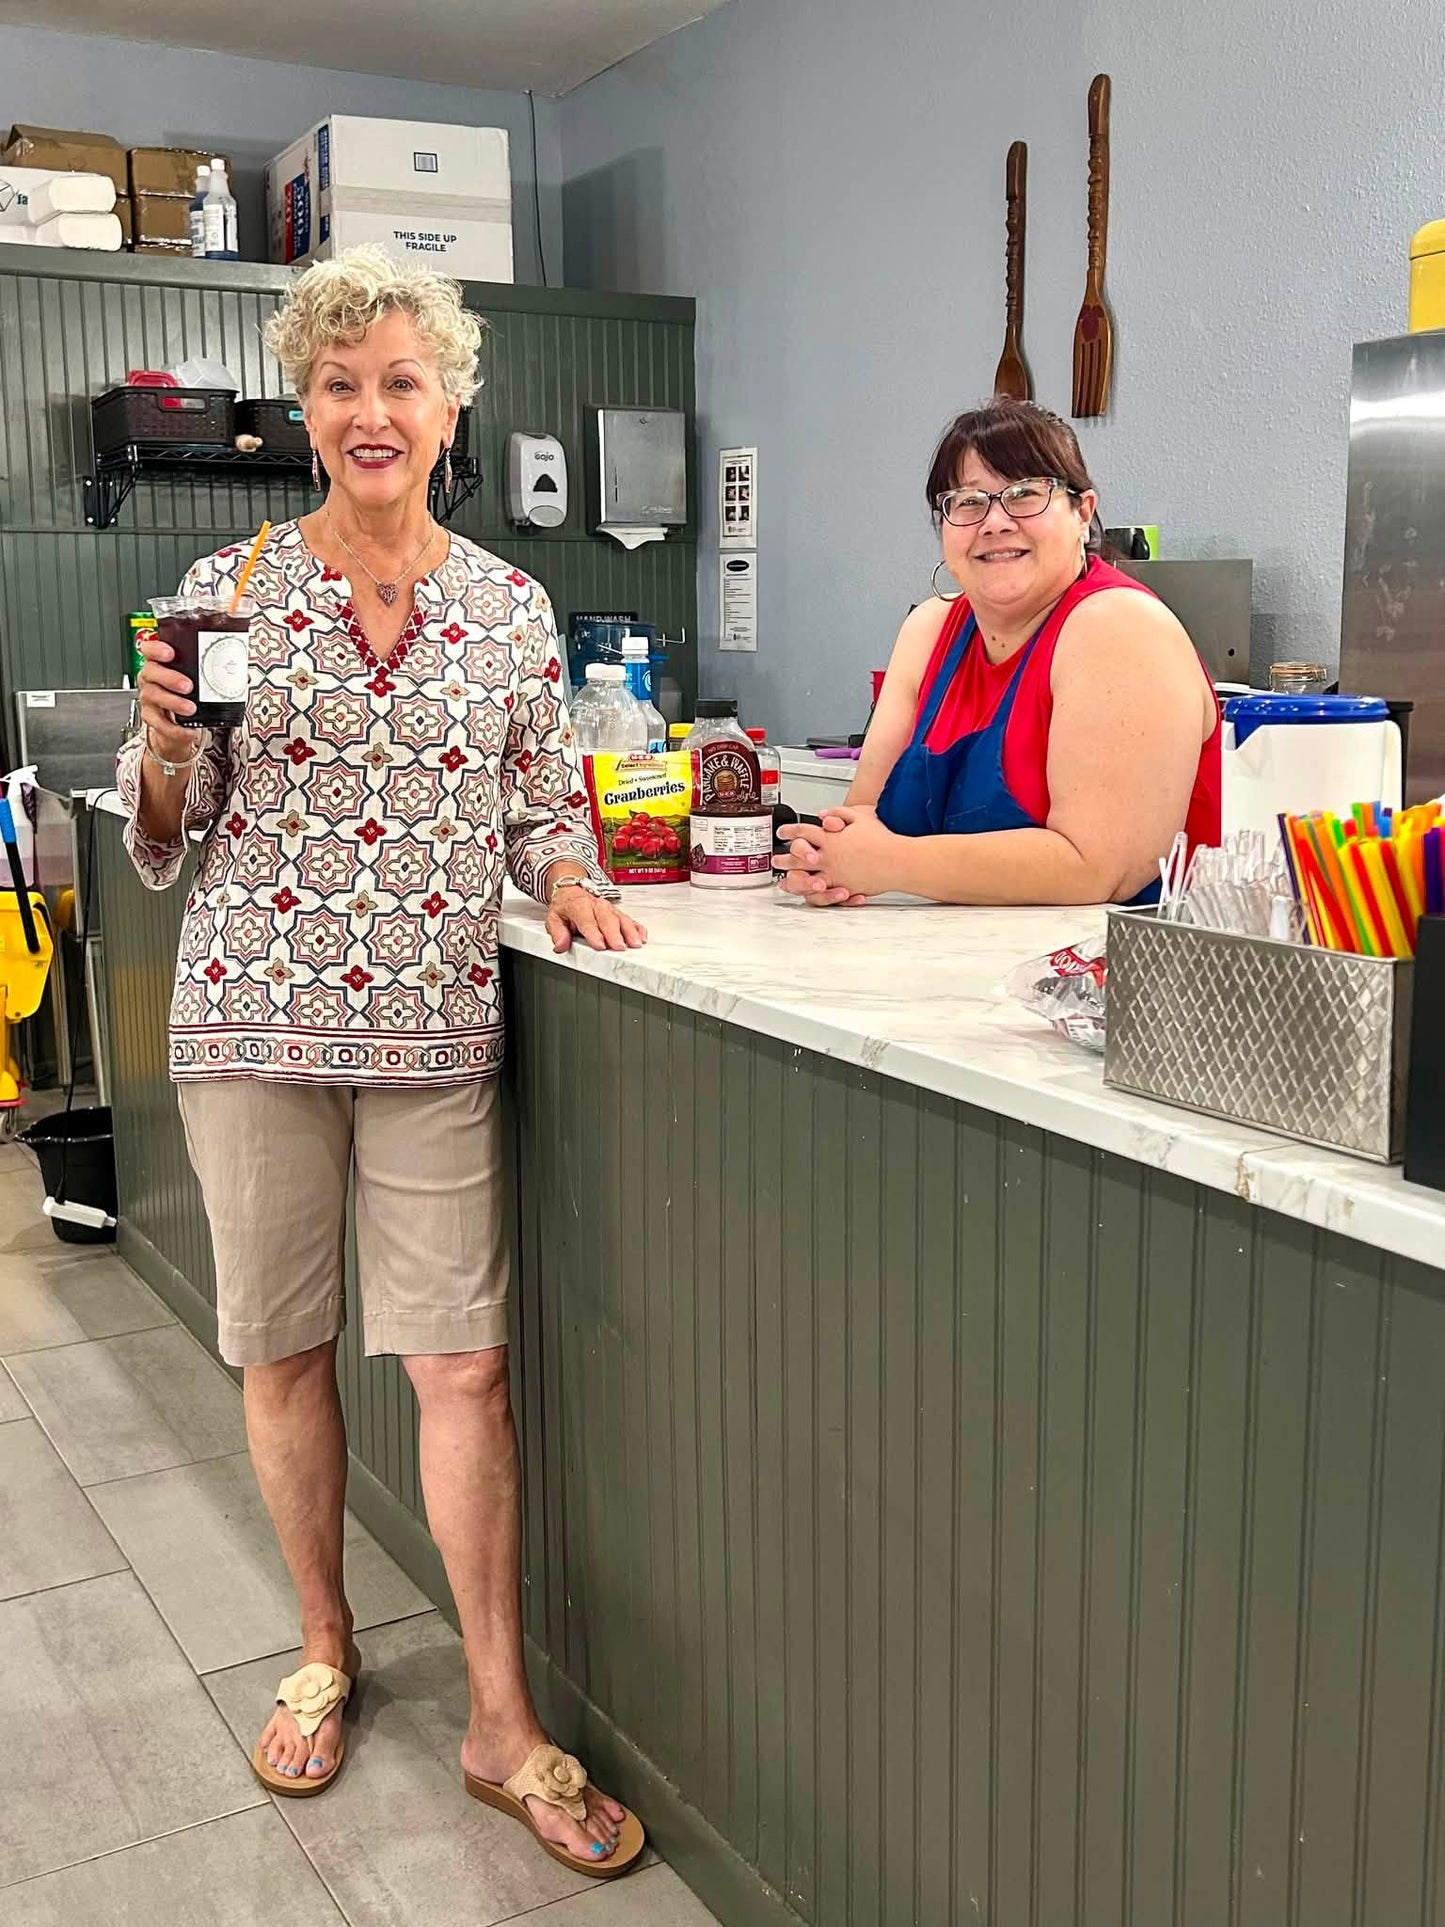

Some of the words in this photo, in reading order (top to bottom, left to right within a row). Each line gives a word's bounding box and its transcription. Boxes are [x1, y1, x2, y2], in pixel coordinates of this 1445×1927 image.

[17, 194, 28, 205] fa
[393, 231, 416, 240] THIS
[418, 233, 441, 242] SIDE
[443, 234, 457, 243] UP
[406, 242, 447, 252] FRAGILE
[720, 755, 729, 767] &
[730, 757, 749, 789] WAFFLE
[618, 778, 634, 786] Dried
[604, 781, 685, 805] Cranberries
